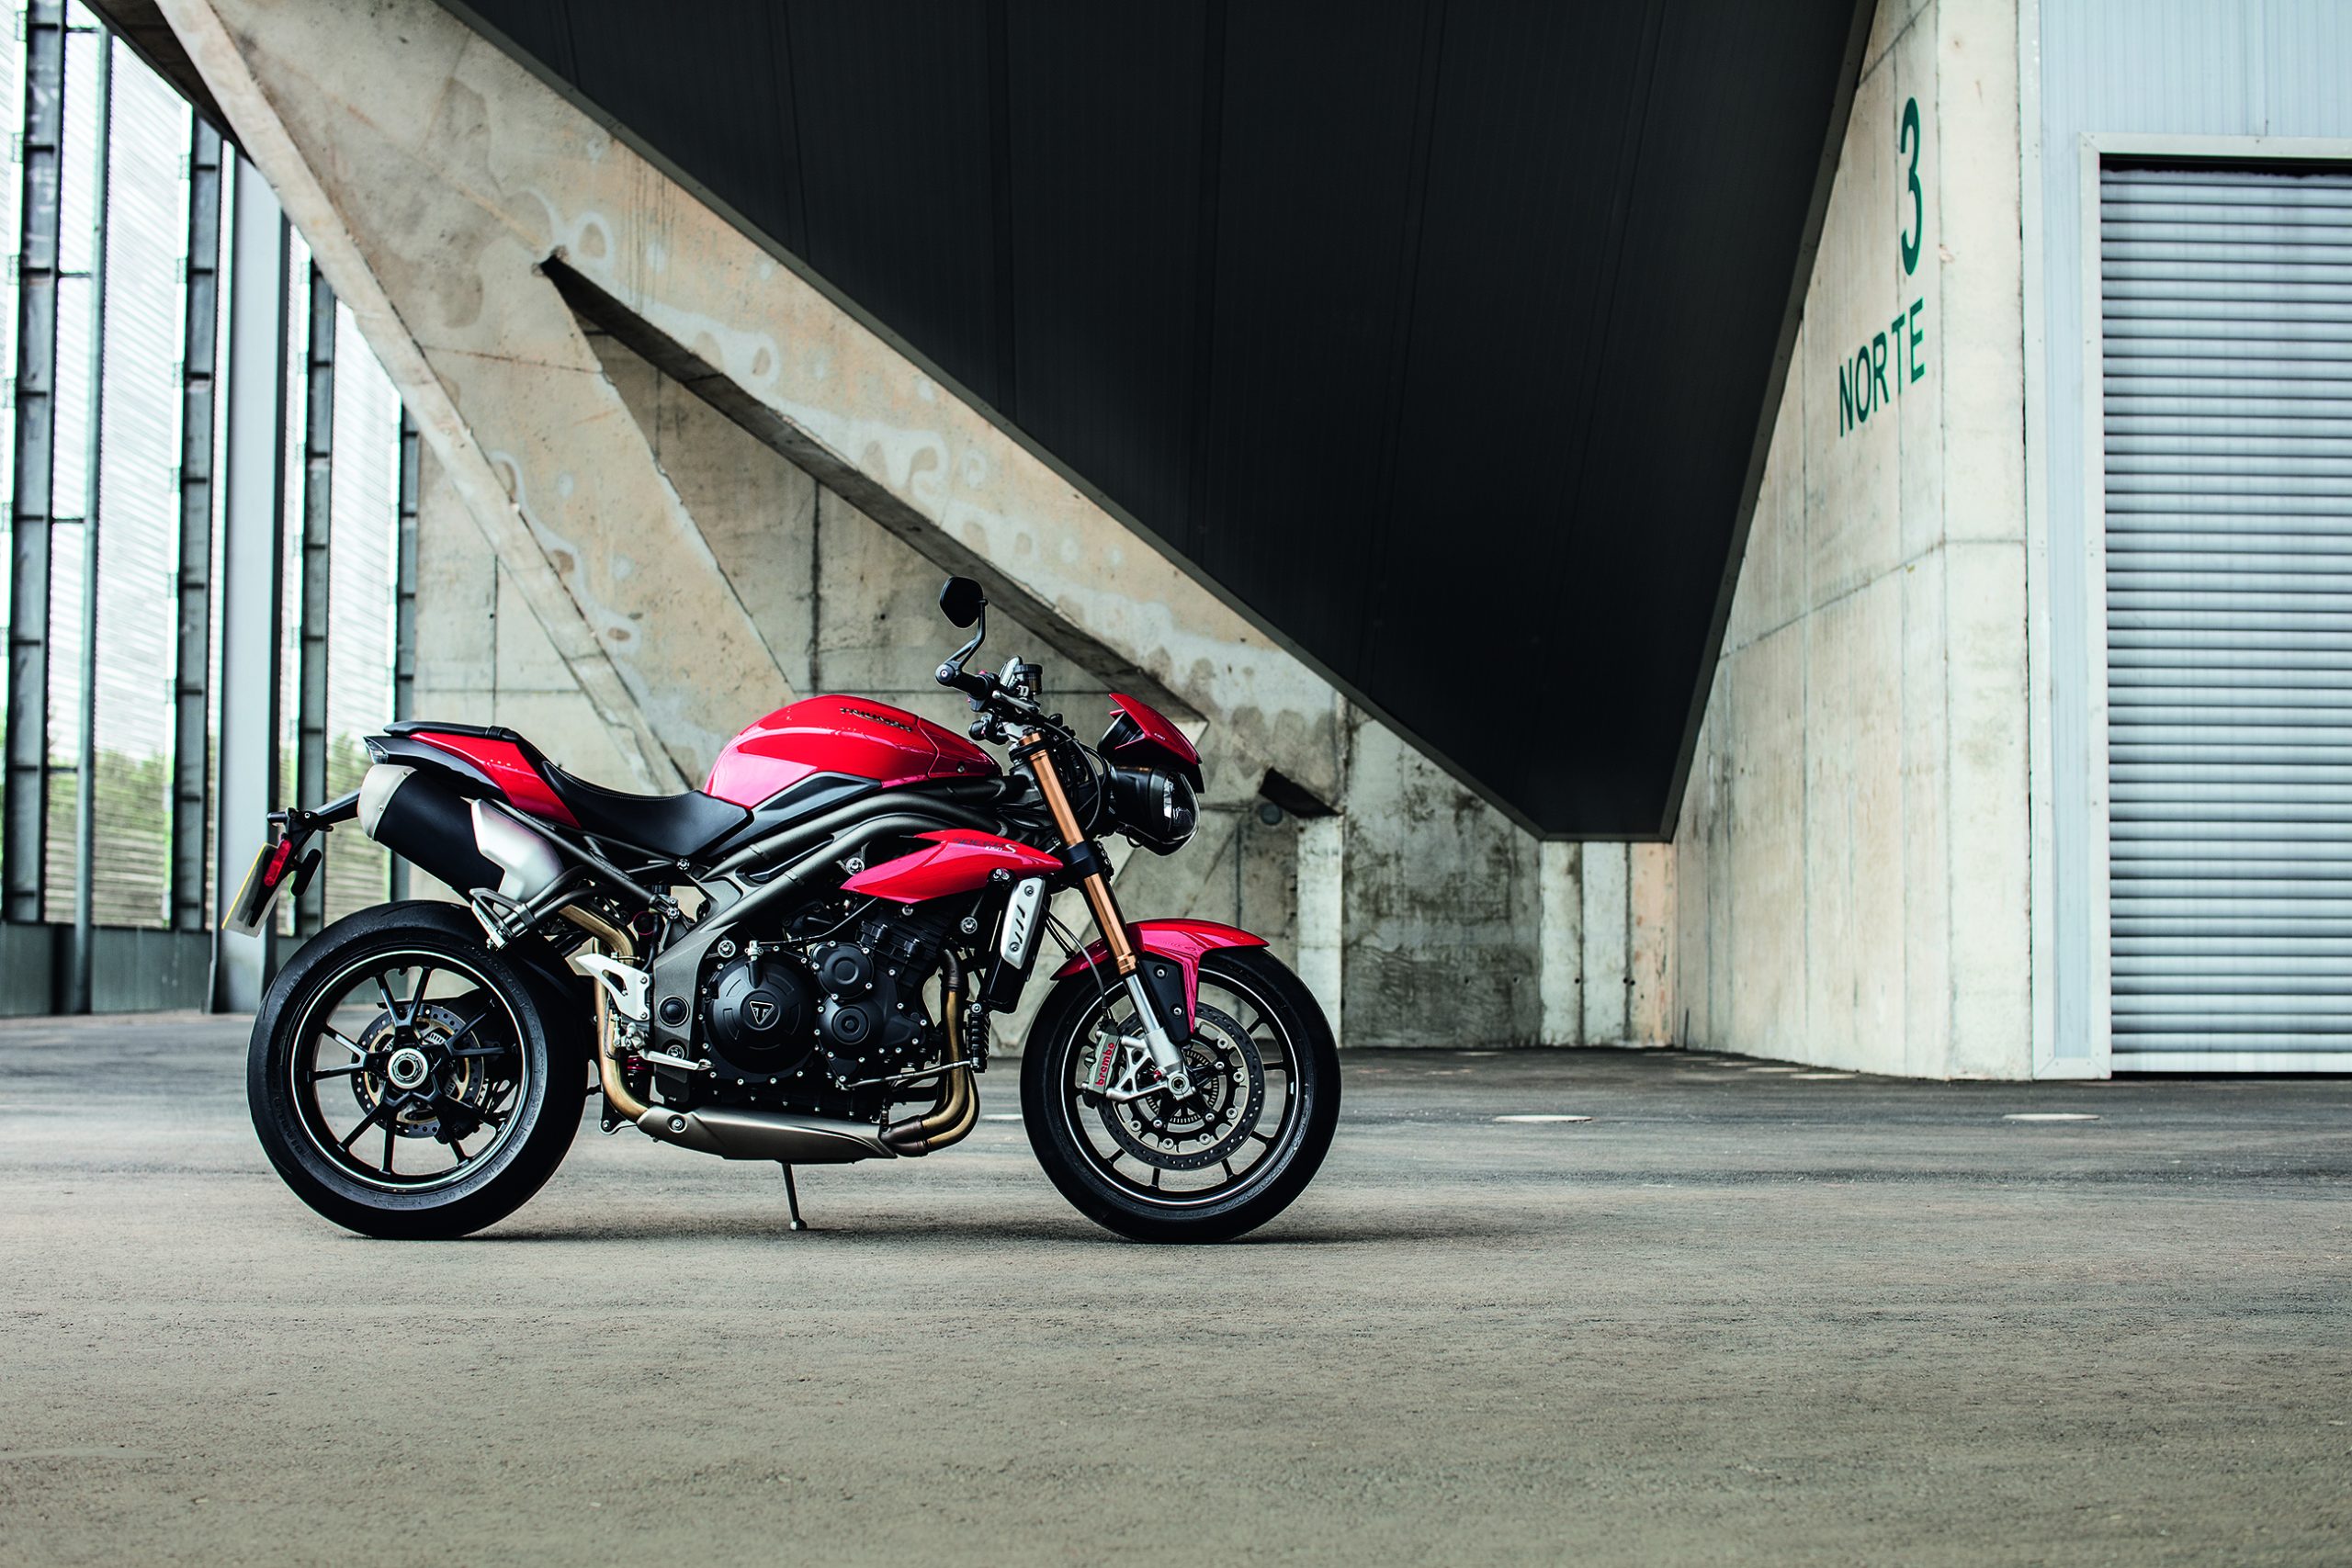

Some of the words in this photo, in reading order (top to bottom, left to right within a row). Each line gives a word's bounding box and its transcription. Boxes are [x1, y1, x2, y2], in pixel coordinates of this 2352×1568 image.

[1900, 97, 1923, 276] 3
[1839, 297, 1925, 437] NORTE
[1095, 1043, 1115, 1086] brembo
